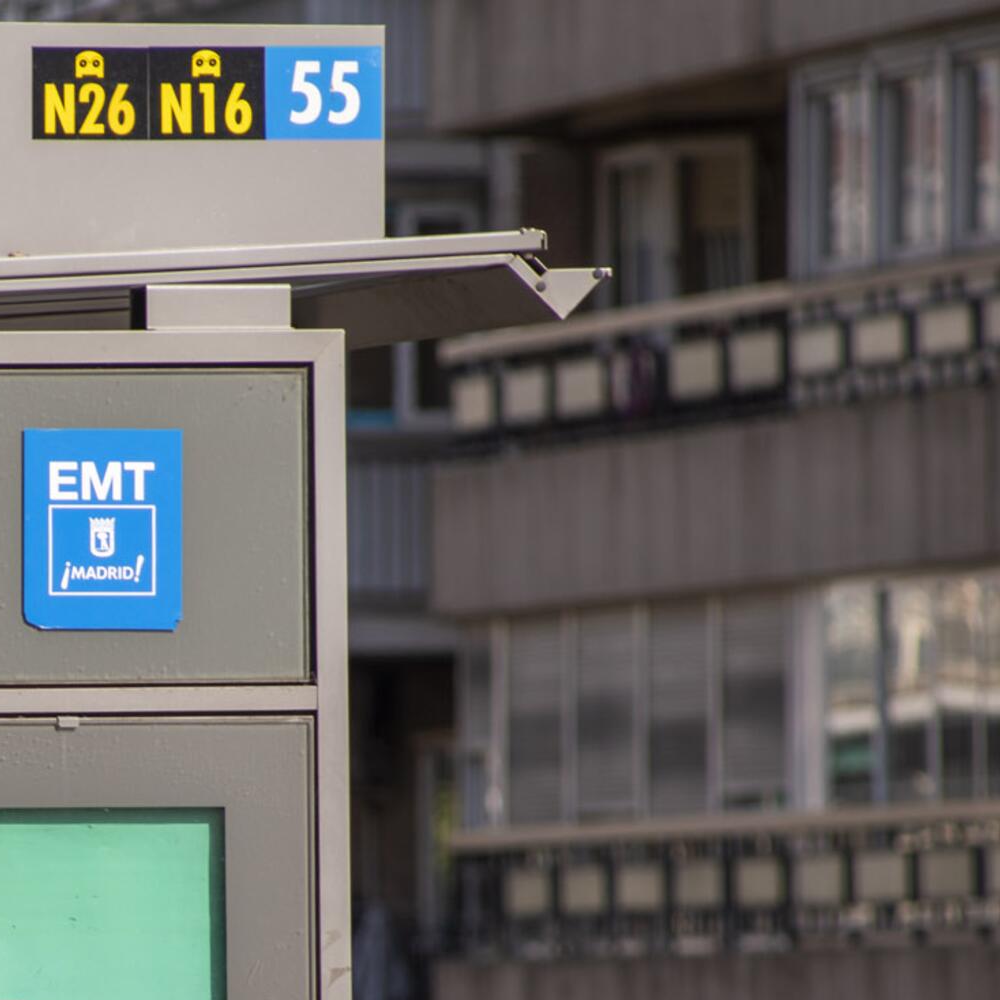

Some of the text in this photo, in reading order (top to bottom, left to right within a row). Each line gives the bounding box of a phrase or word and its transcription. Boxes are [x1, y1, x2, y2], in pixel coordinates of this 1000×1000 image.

[43, 82, 136, 135] N26
[160, 82, 253, 135] N16
[289, 60, 361, 125] 55
[48, 460, 156, 501] EMT
[60, 554, 145, 590] ¡MADRID!
